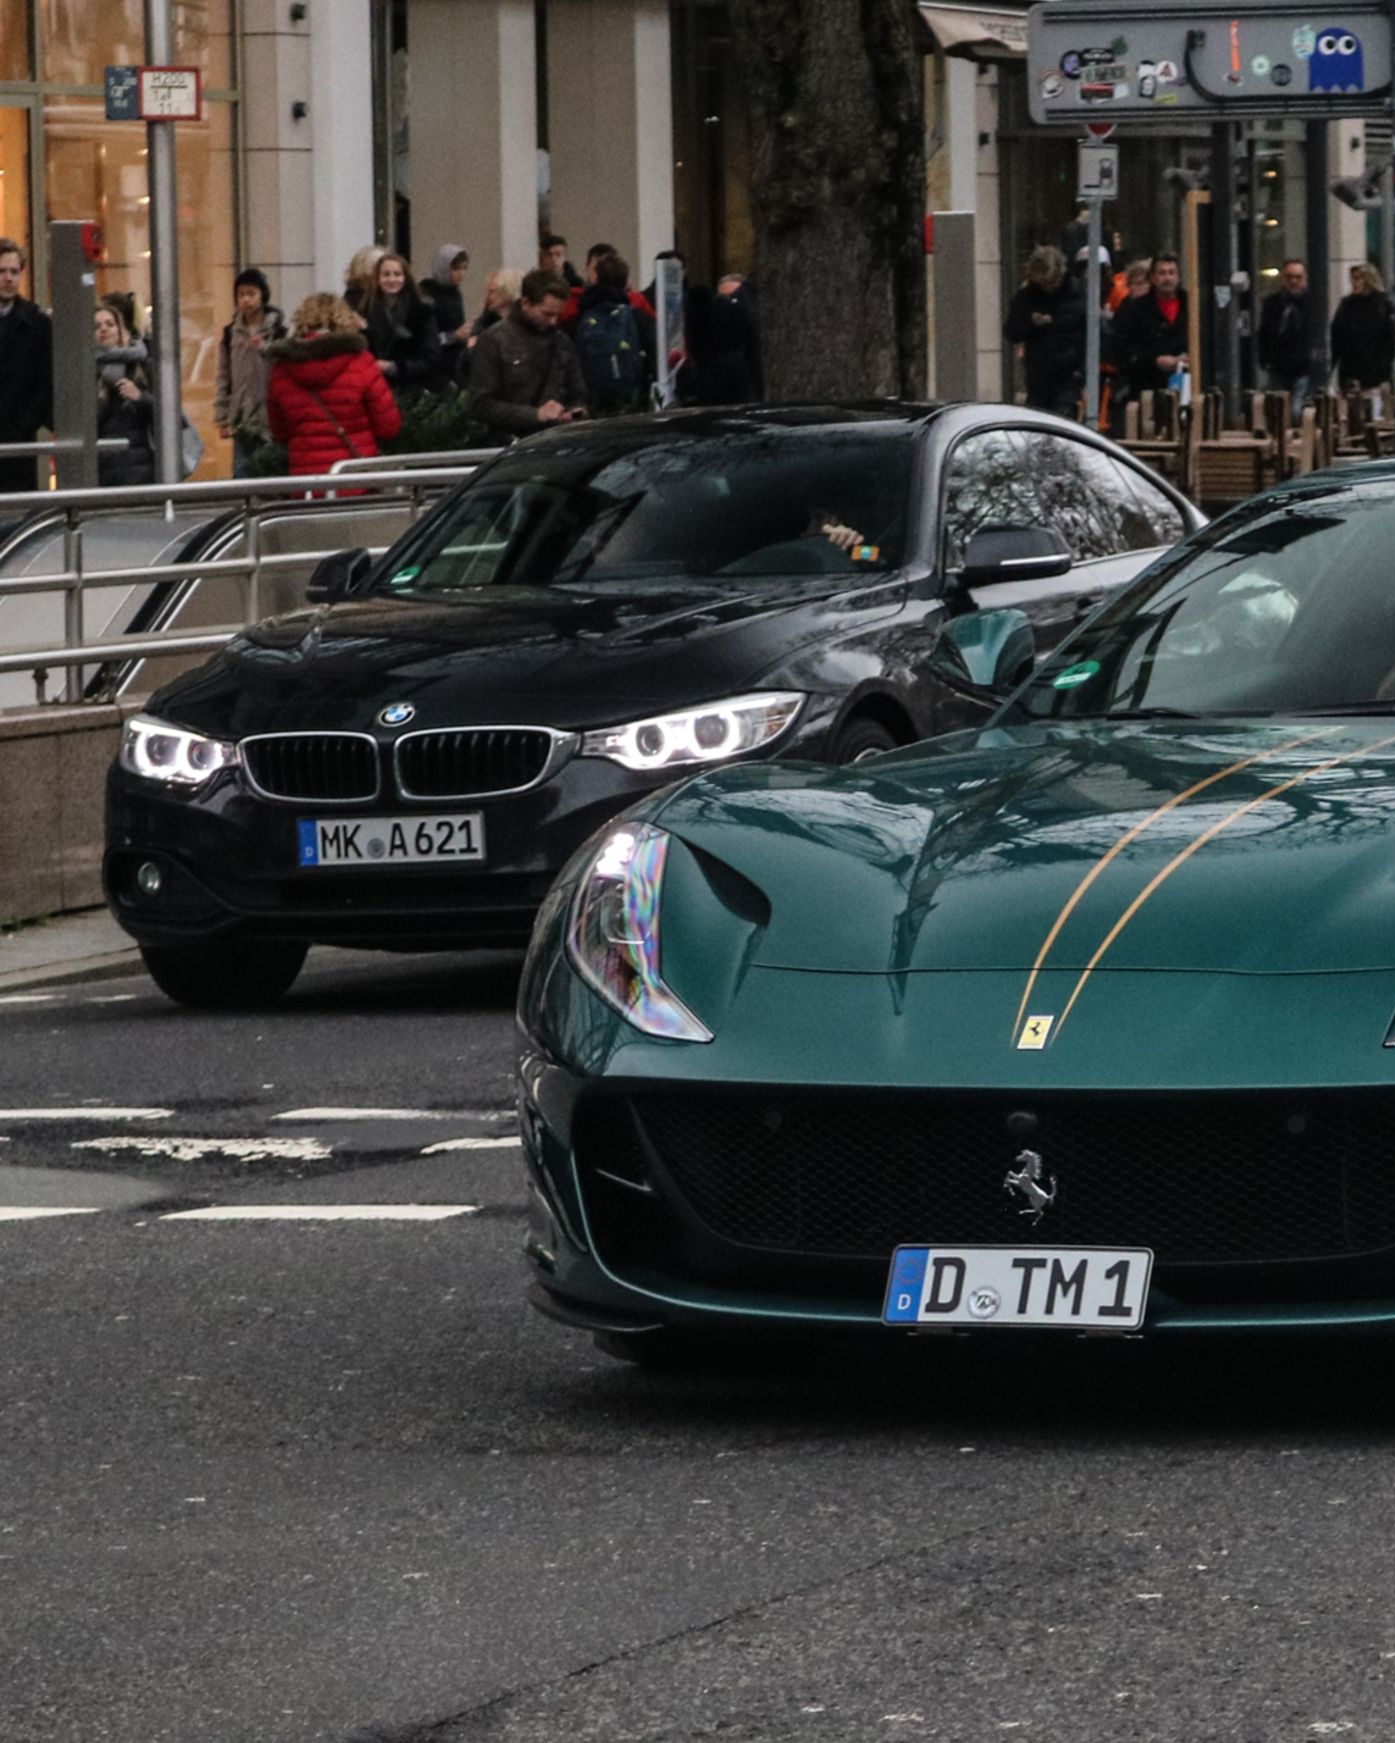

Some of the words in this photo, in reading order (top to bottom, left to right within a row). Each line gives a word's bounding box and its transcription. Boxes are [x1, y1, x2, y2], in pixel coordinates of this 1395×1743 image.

[320, 824, 363, 859] MK
[897, 1294, 912, 1311] D
[924, 1257, 967, 1313] D
